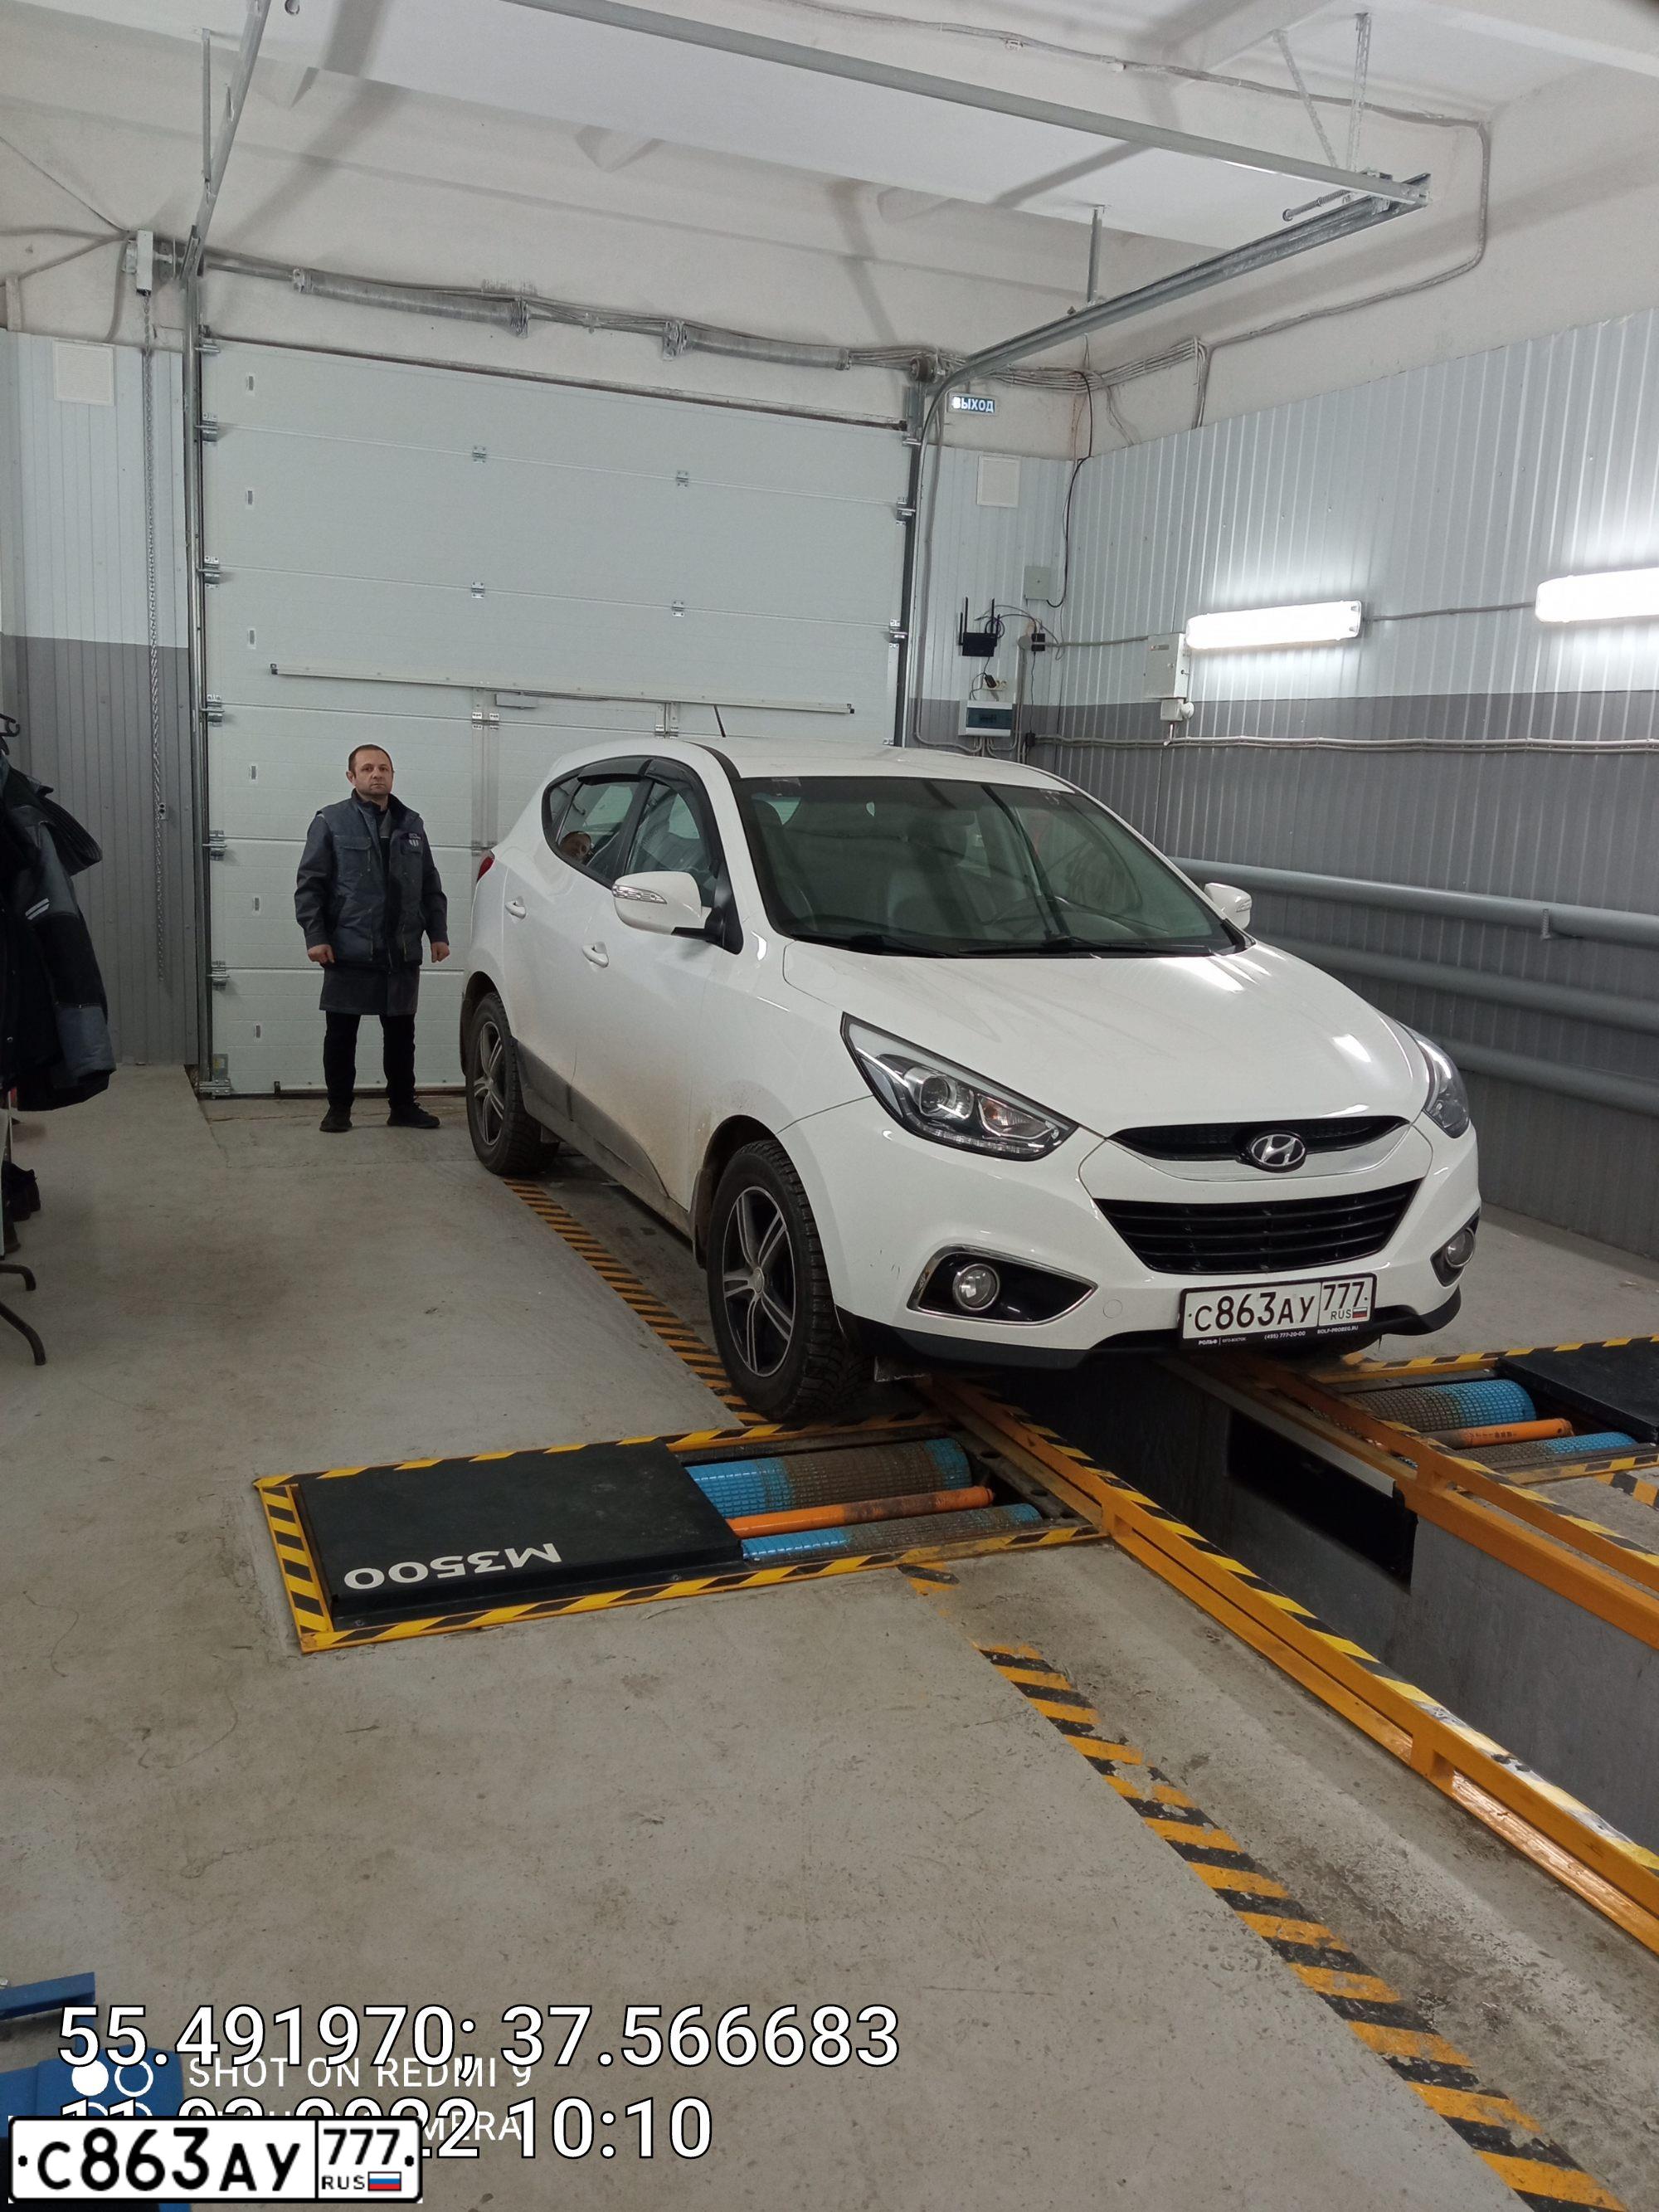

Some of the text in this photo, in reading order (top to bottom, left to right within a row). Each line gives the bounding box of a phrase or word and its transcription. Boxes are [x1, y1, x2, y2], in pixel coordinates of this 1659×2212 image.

[1194, 1281, 1365, 1332] С863АУ 777
[1330, 1308, 1352, 1321] RUS
[343, 1542, 562, 1590] M3500
